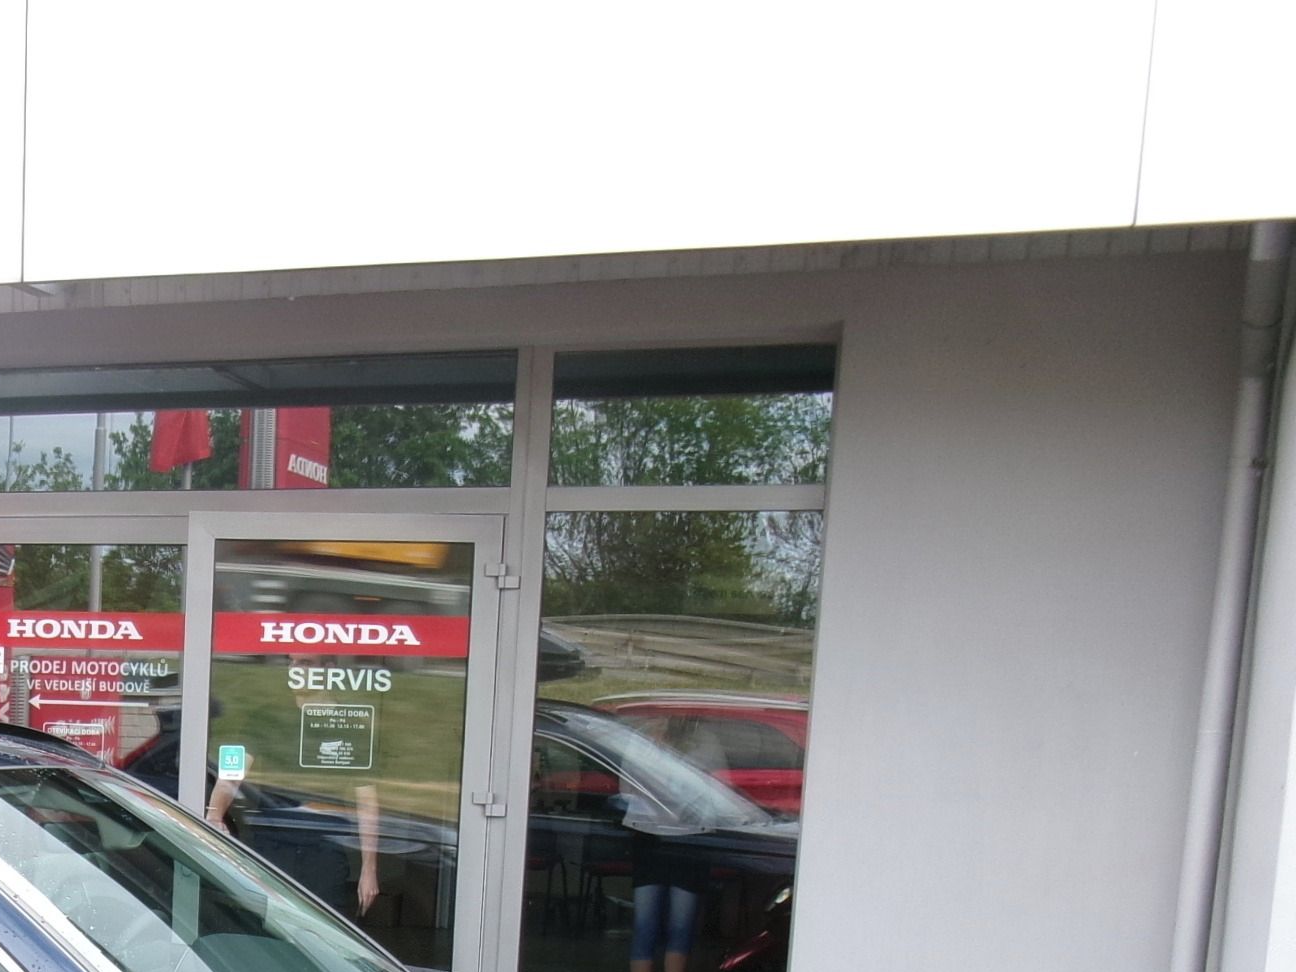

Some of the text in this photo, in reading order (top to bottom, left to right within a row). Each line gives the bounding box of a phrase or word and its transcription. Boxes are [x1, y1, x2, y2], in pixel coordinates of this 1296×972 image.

[7, 618, 144, 640] HONDA
[260, 622, 421, 646] HONDA
[10, 659, 67, 675] PRODEJ
[71, 658, 169, 678] MOTOCYKLŮ
[27, 677, 151, 694] VE VEDLEJŠÍ BUDOVĚ
[287, 666, 392, 692] SERVIS
[347, 710, 370, 718] DOBA
